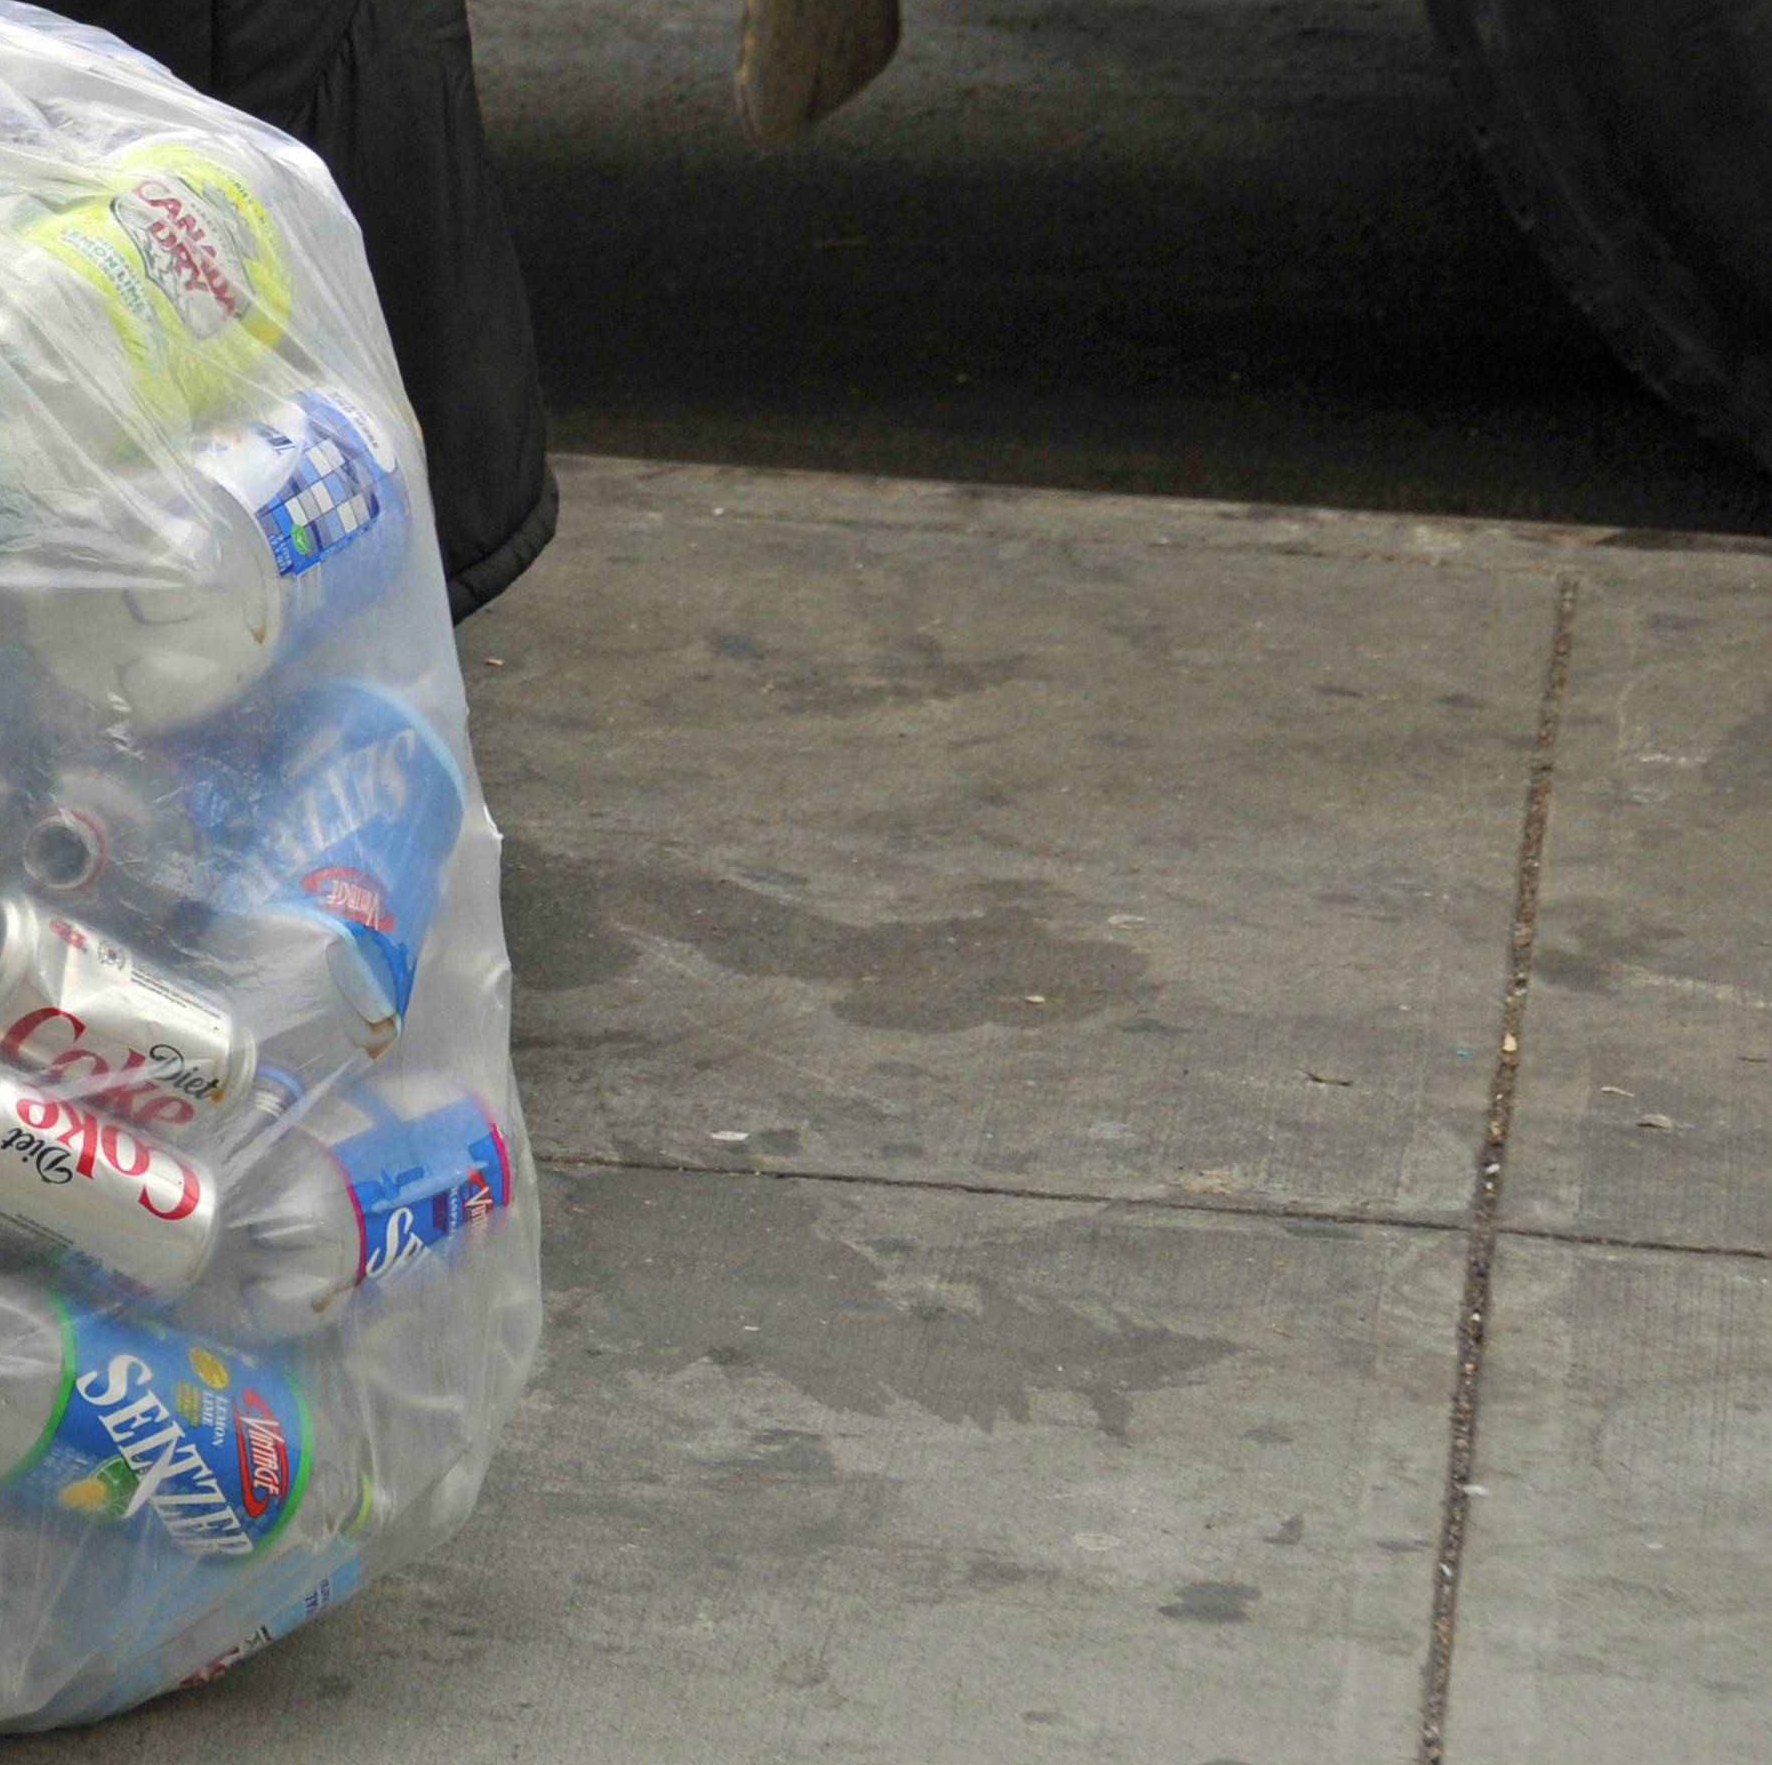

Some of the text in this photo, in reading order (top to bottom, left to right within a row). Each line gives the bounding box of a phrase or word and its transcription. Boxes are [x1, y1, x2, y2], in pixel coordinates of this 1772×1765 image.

[132, 178, 242, 318] CANADA
[146, 220, 210, 296] DRY
[0, 1005, 197, 1125] Coke
[148, 1041, 223, 1103] Diet
[15, 1086, 202, 1222] Coke
[74, 1352, 255, 1557] SELTZER
[199, 1389, 217, 1429] LIME
[211, 1393, 230, 1449] LEMON
[233, 1412, 283, 1503] VINTAGE
